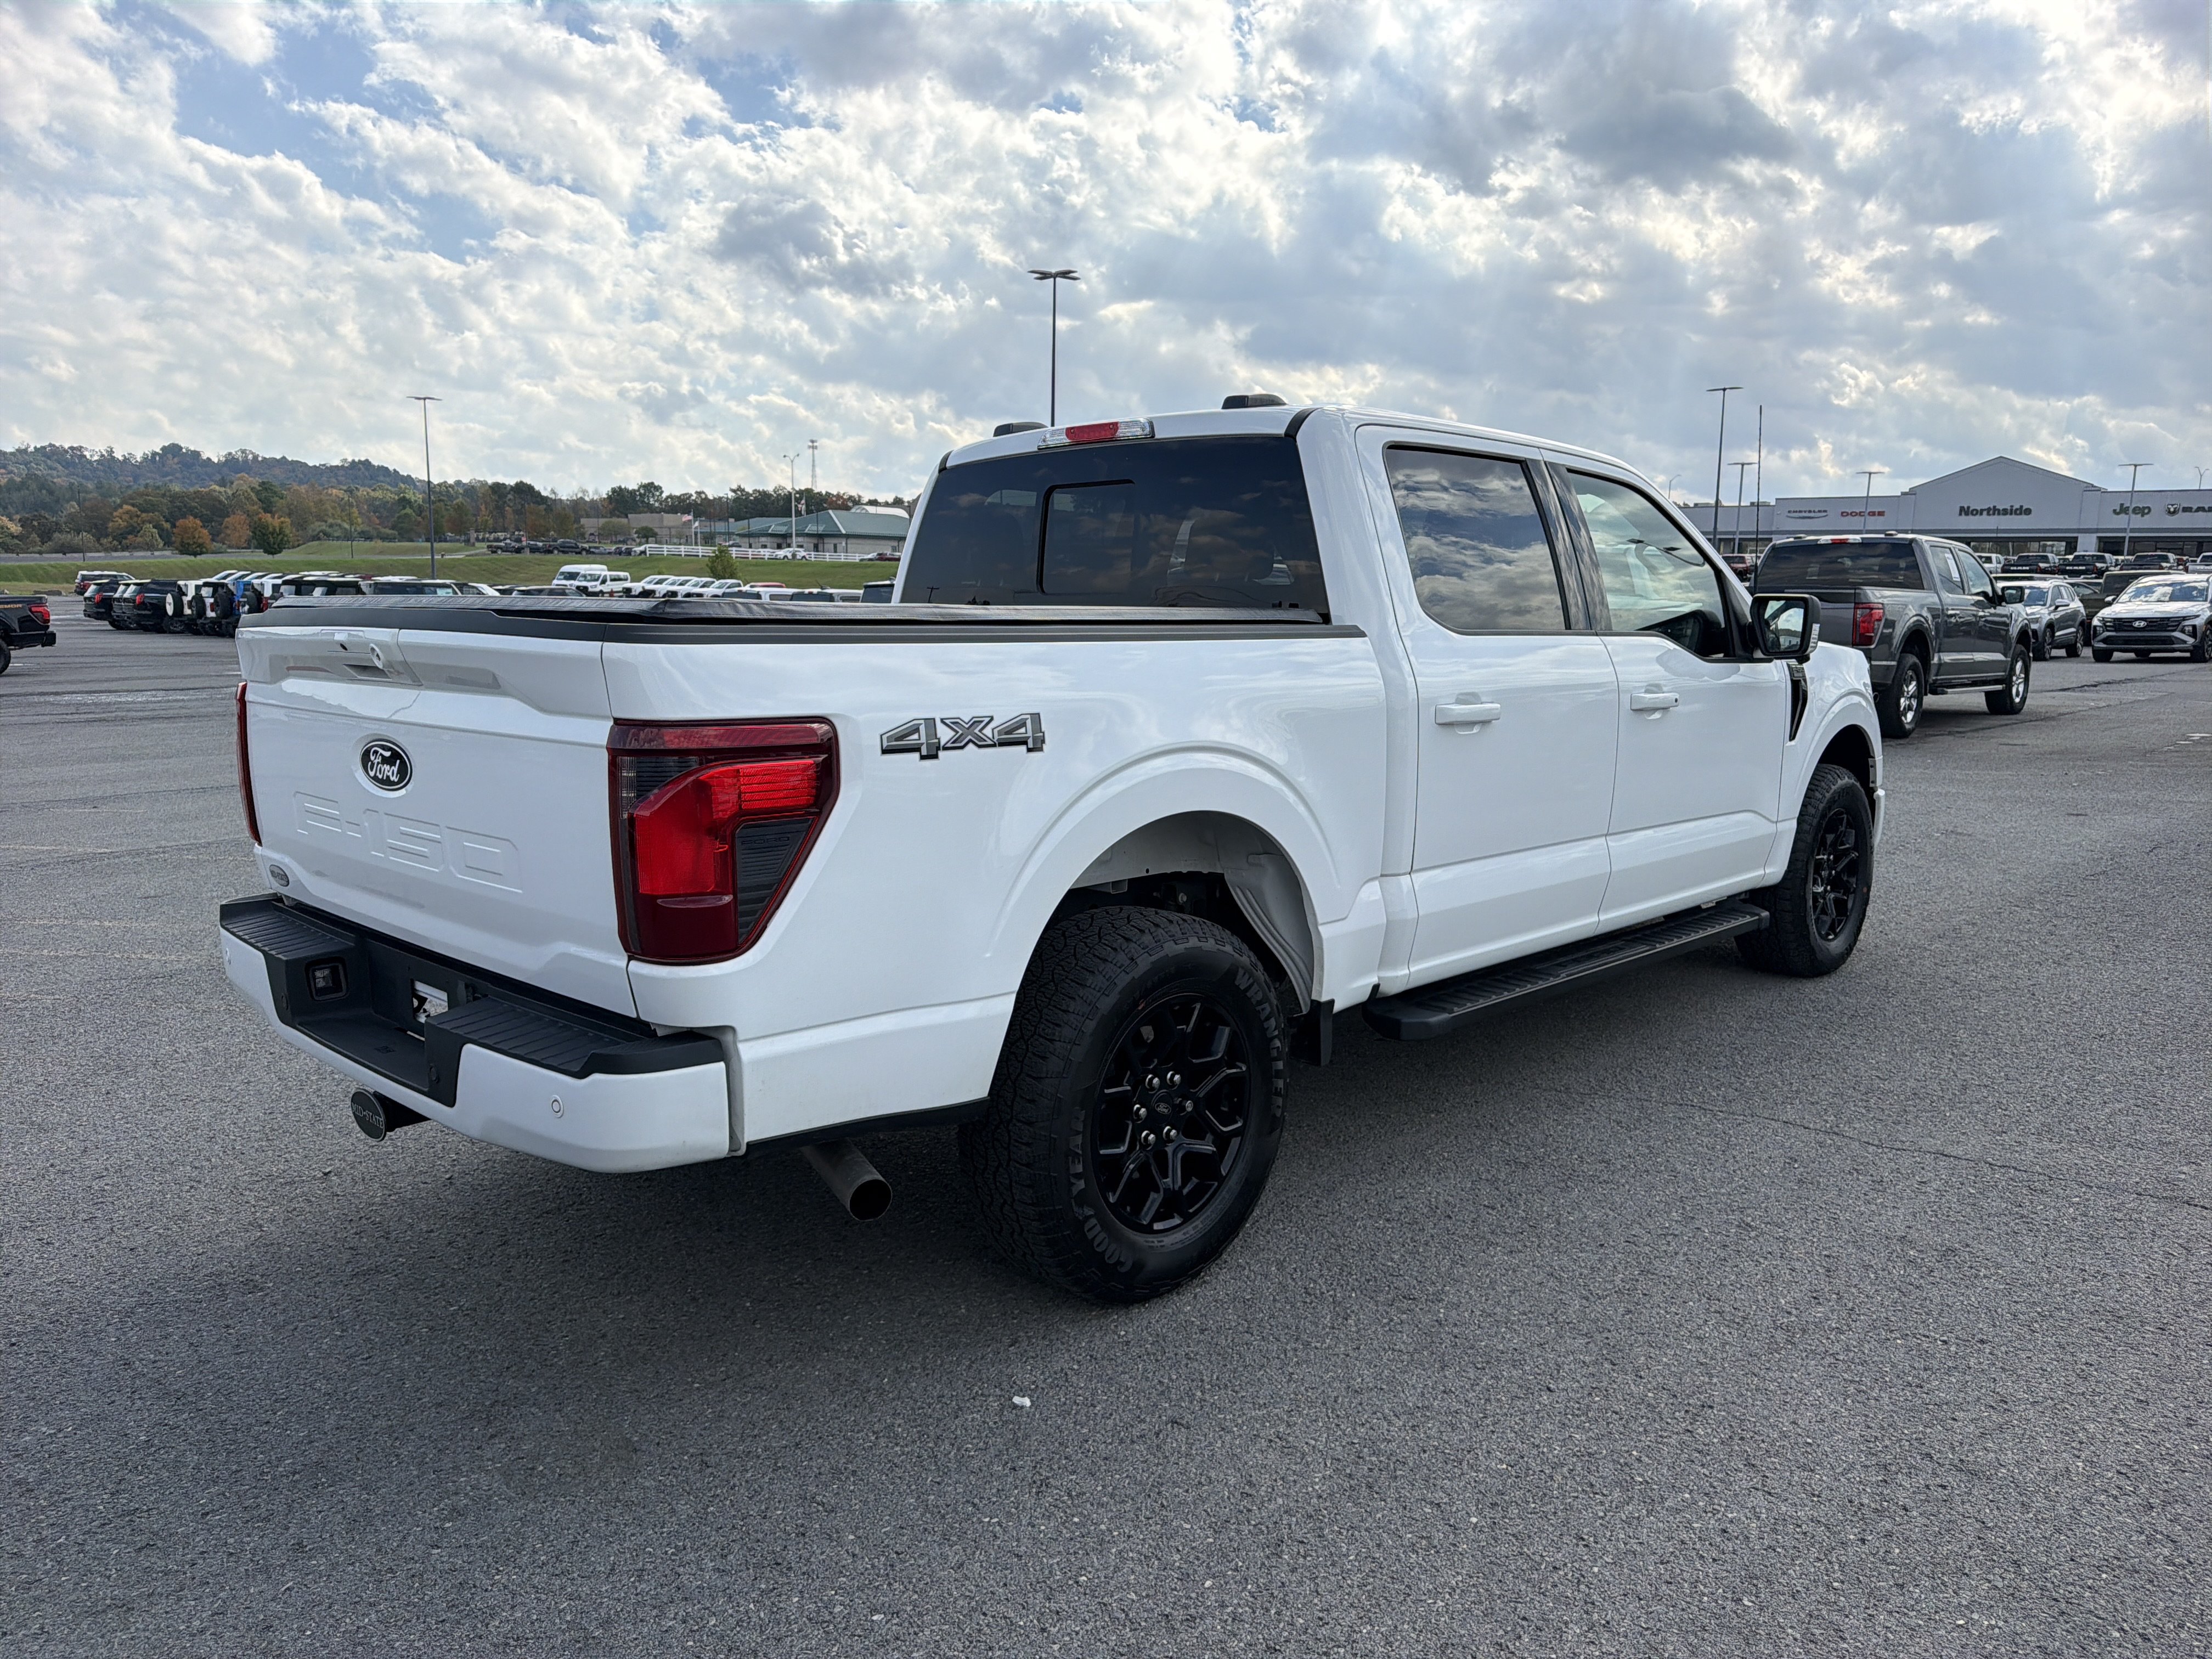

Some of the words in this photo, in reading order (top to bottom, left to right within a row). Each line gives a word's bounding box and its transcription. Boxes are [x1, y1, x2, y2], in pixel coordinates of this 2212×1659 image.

[1959, 505, 2032, 516] Northside
[2113, 503, 2152, 517] Jeep
[368, 747, 400, 782] Ford
[293, 791, 523, 893] F-150
[741, 837, 789, 845] FORD
[1234, 967, 1284, 1118] WRANGLER
[1069, 1107, 1134, 1273] GOODYEAR
